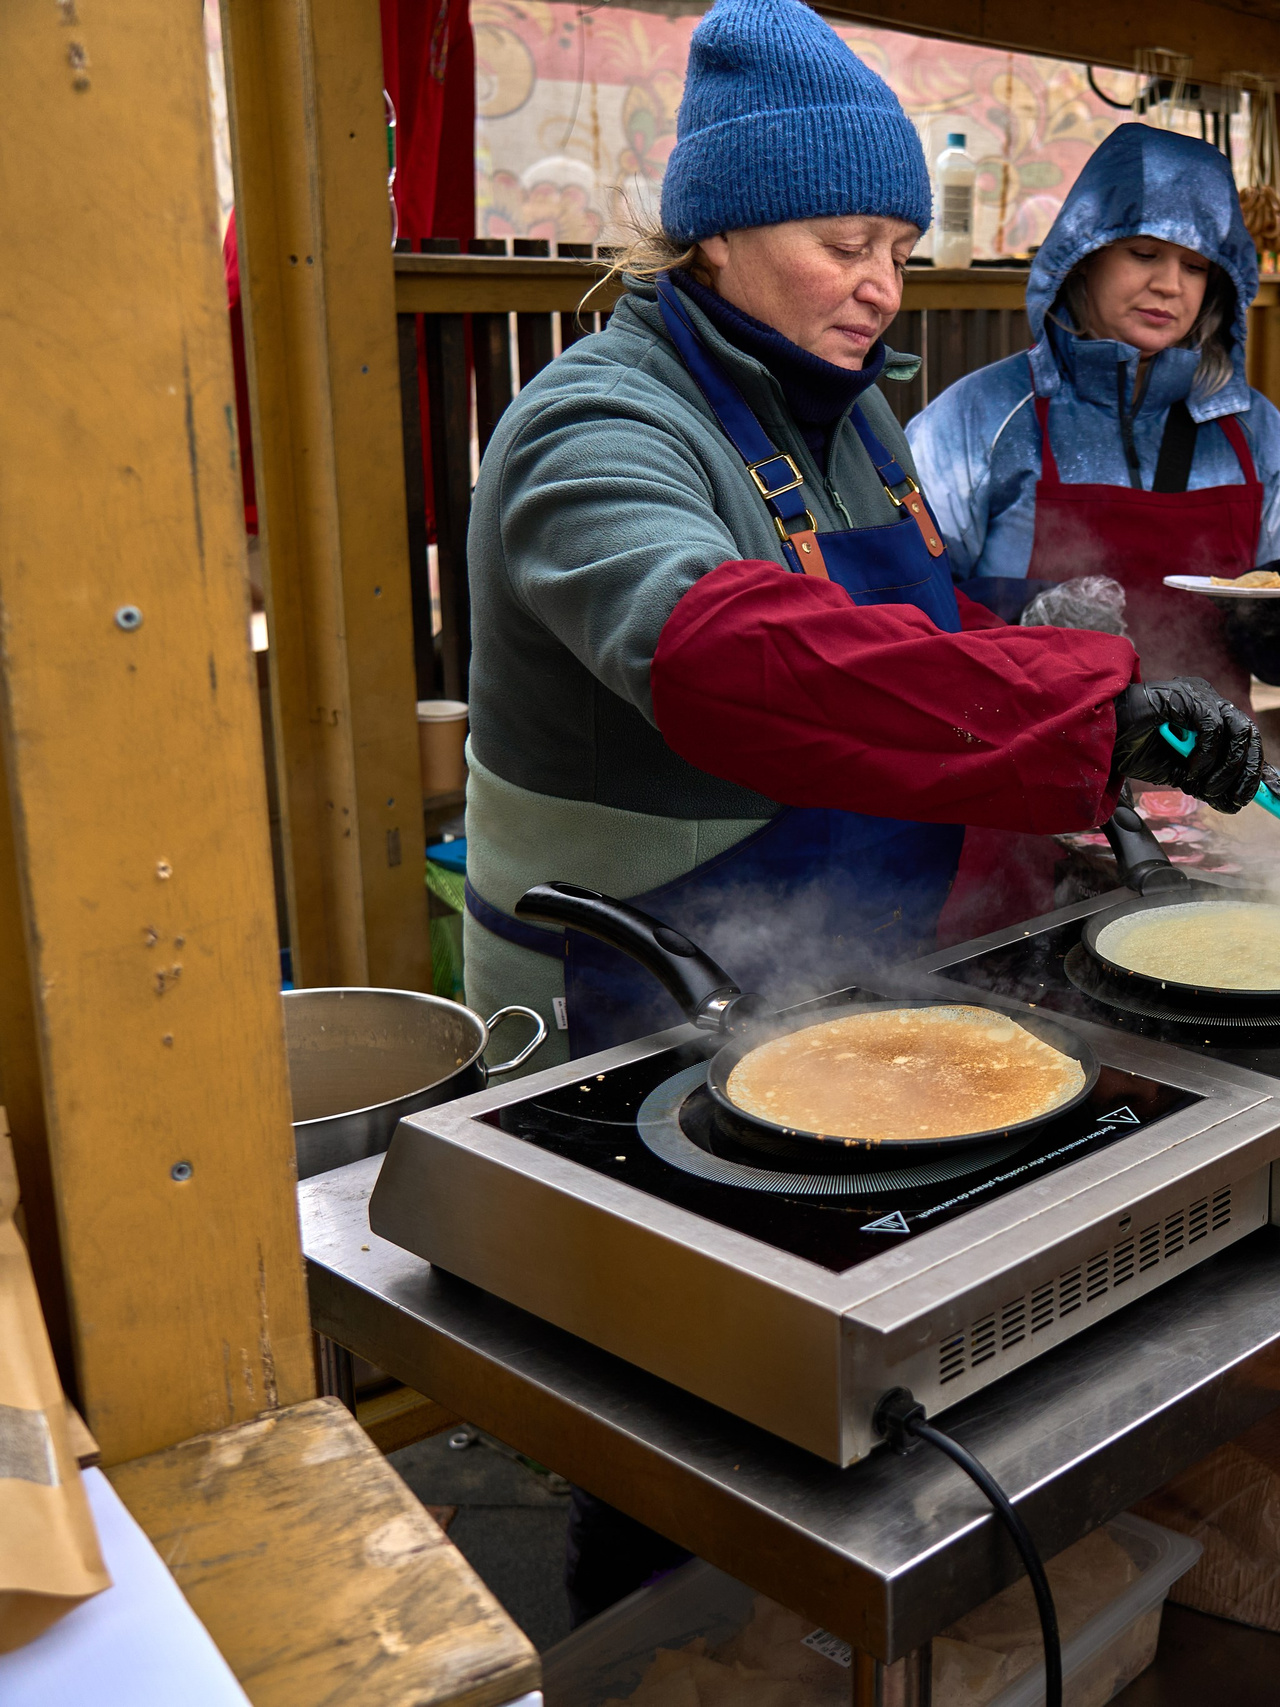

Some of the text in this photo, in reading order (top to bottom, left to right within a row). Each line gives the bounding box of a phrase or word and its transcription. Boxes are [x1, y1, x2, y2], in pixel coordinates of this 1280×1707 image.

[1078, 886, 1101, 898] nuvol
[1088, 1124, 1116, 1140] Surface
[1058, 1138, 1088, 1155] remains
[1028, 1156, 1046, 1168] after
[1046, 1150, 1059, 1160] hot
[994, 1165, 1028, 1183] cooking,
[970, 1180, 995, 1196] please
[944, 1197, 958, 1208] not
[916, 1205, 944, 1220] touch.
